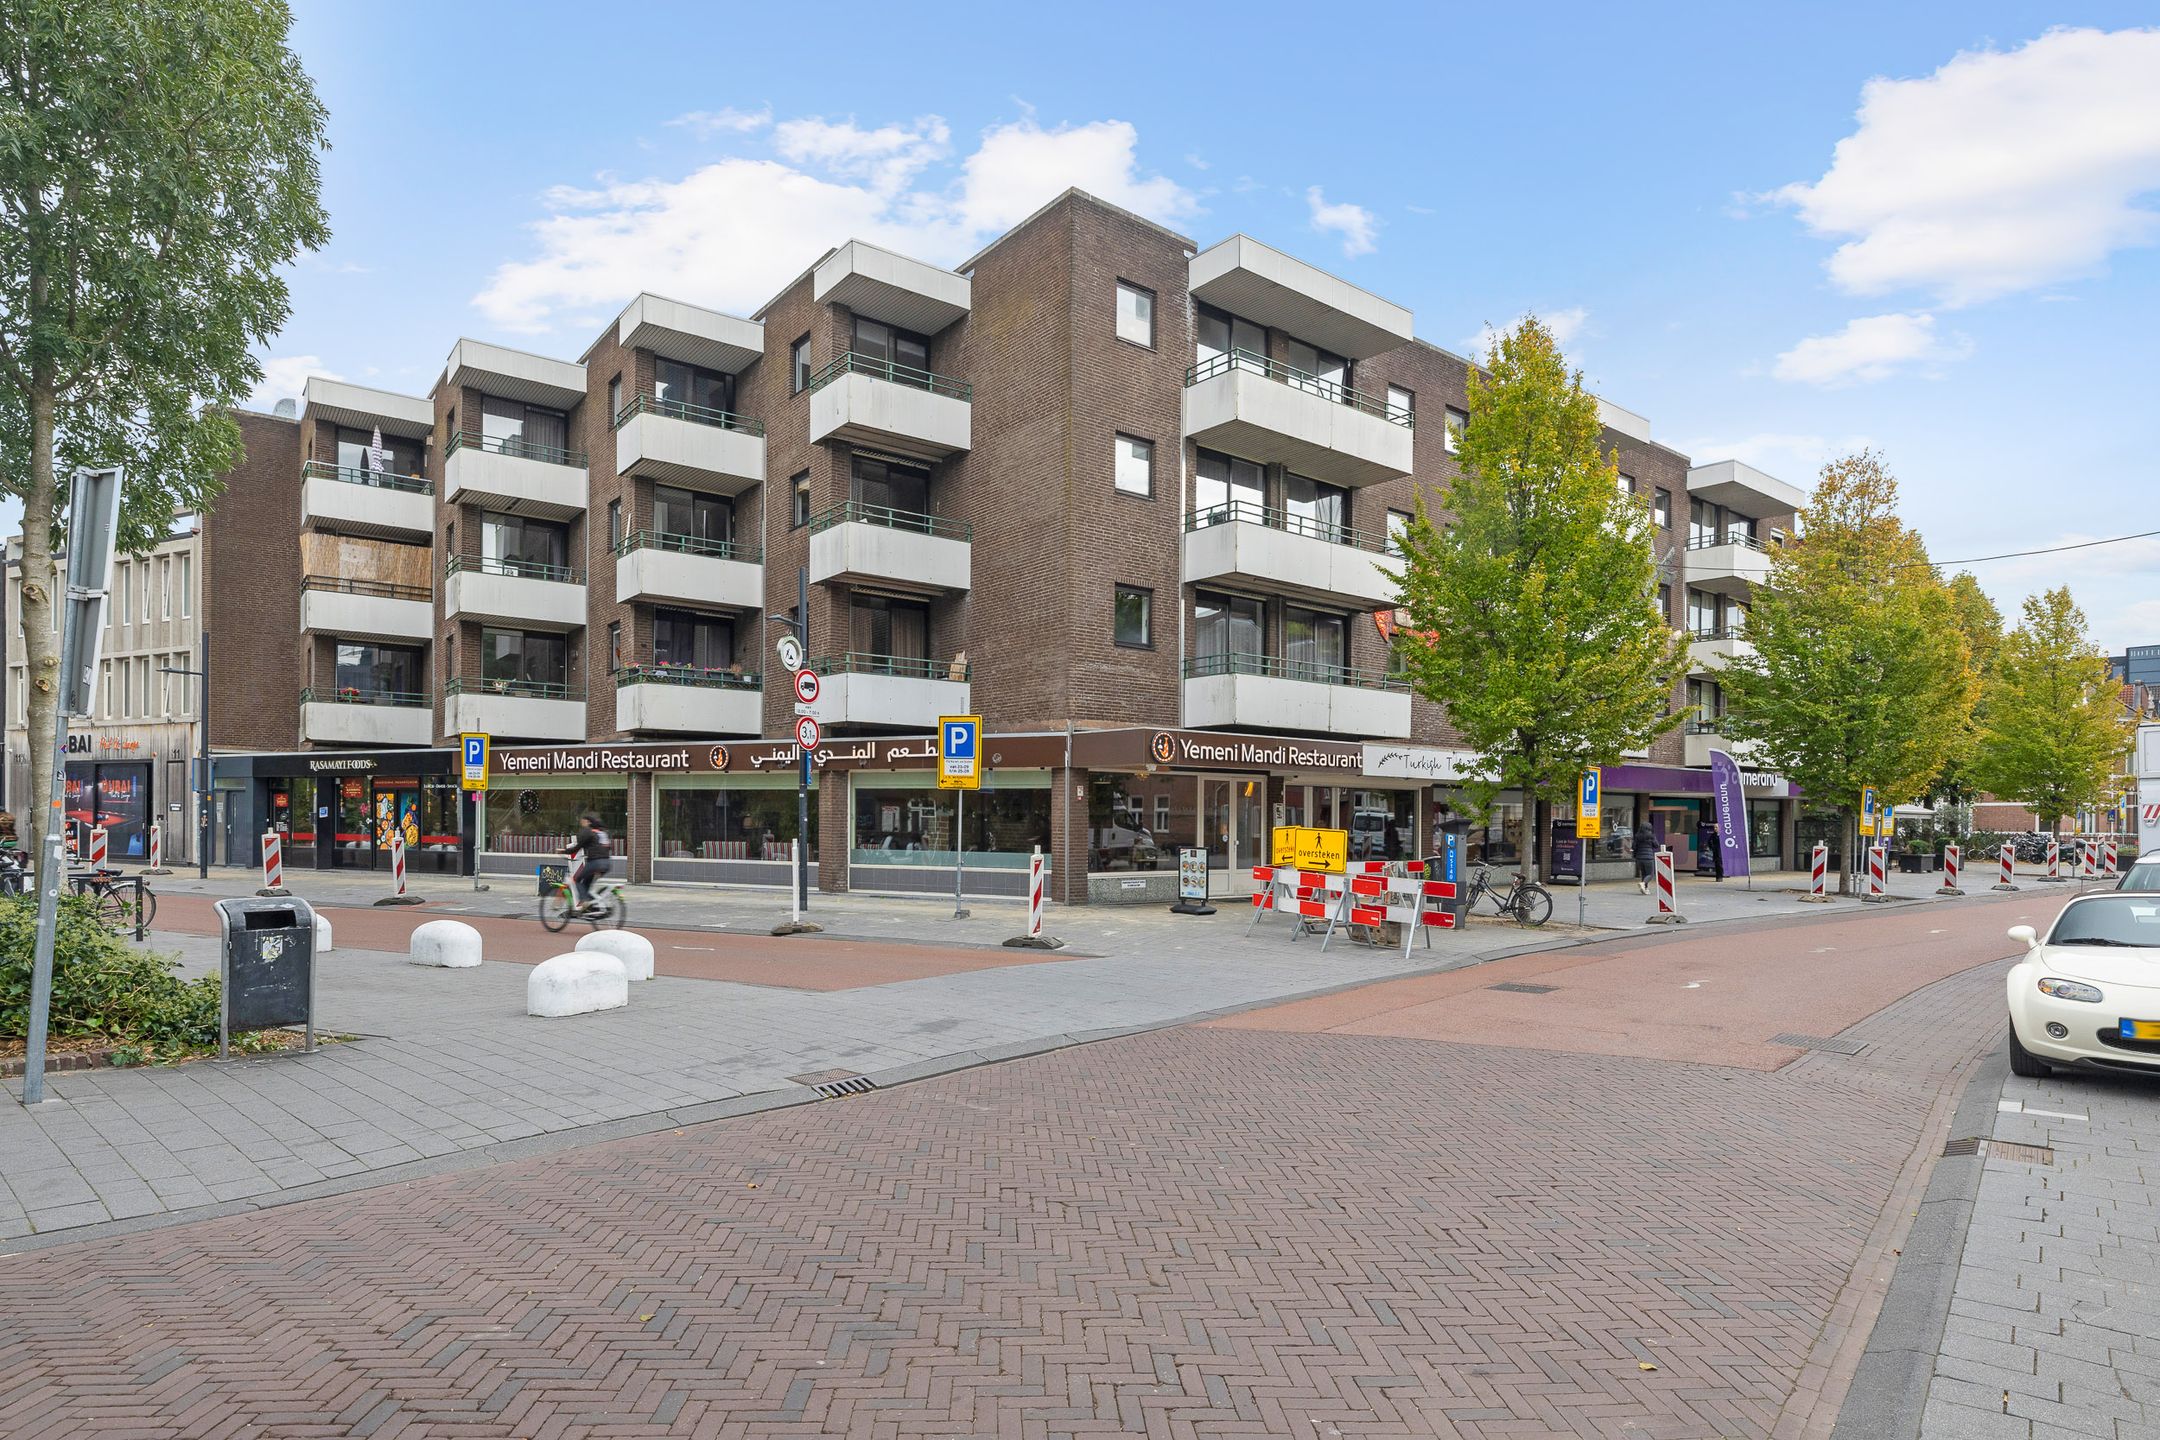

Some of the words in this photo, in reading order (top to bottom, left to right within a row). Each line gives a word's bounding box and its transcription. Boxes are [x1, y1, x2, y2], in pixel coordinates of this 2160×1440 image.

[68, 735, 91, 753] BAI
[887, 740, 938, 763] طعم
[951, 727, 968, 754] P
[470, 741, 480, 763] P
[500, 753, 551, 770] Yemeni
[553, 751, 598, 769] Mandi
[601, 749, 689, 768] Restaurant
[1180, 739, 1238, 762] Yemeni
[1241, 743, 1286, 765] Mandi
[1289, 747, 1363, 768] Restaurant
[310, 760, 346, 771] RASAMAYI
[347, 760, 371, 769] FOODS
[1404, 754, 1441, 776] Turkish
[66, 780, 80, 793] BAI
[1586, 775, 1596, 801] P
[1720, 783, 1733, 835] cameranu
[1447, 835, 1454, 845] P
[1298, 850, 1340, 860] oversteken
